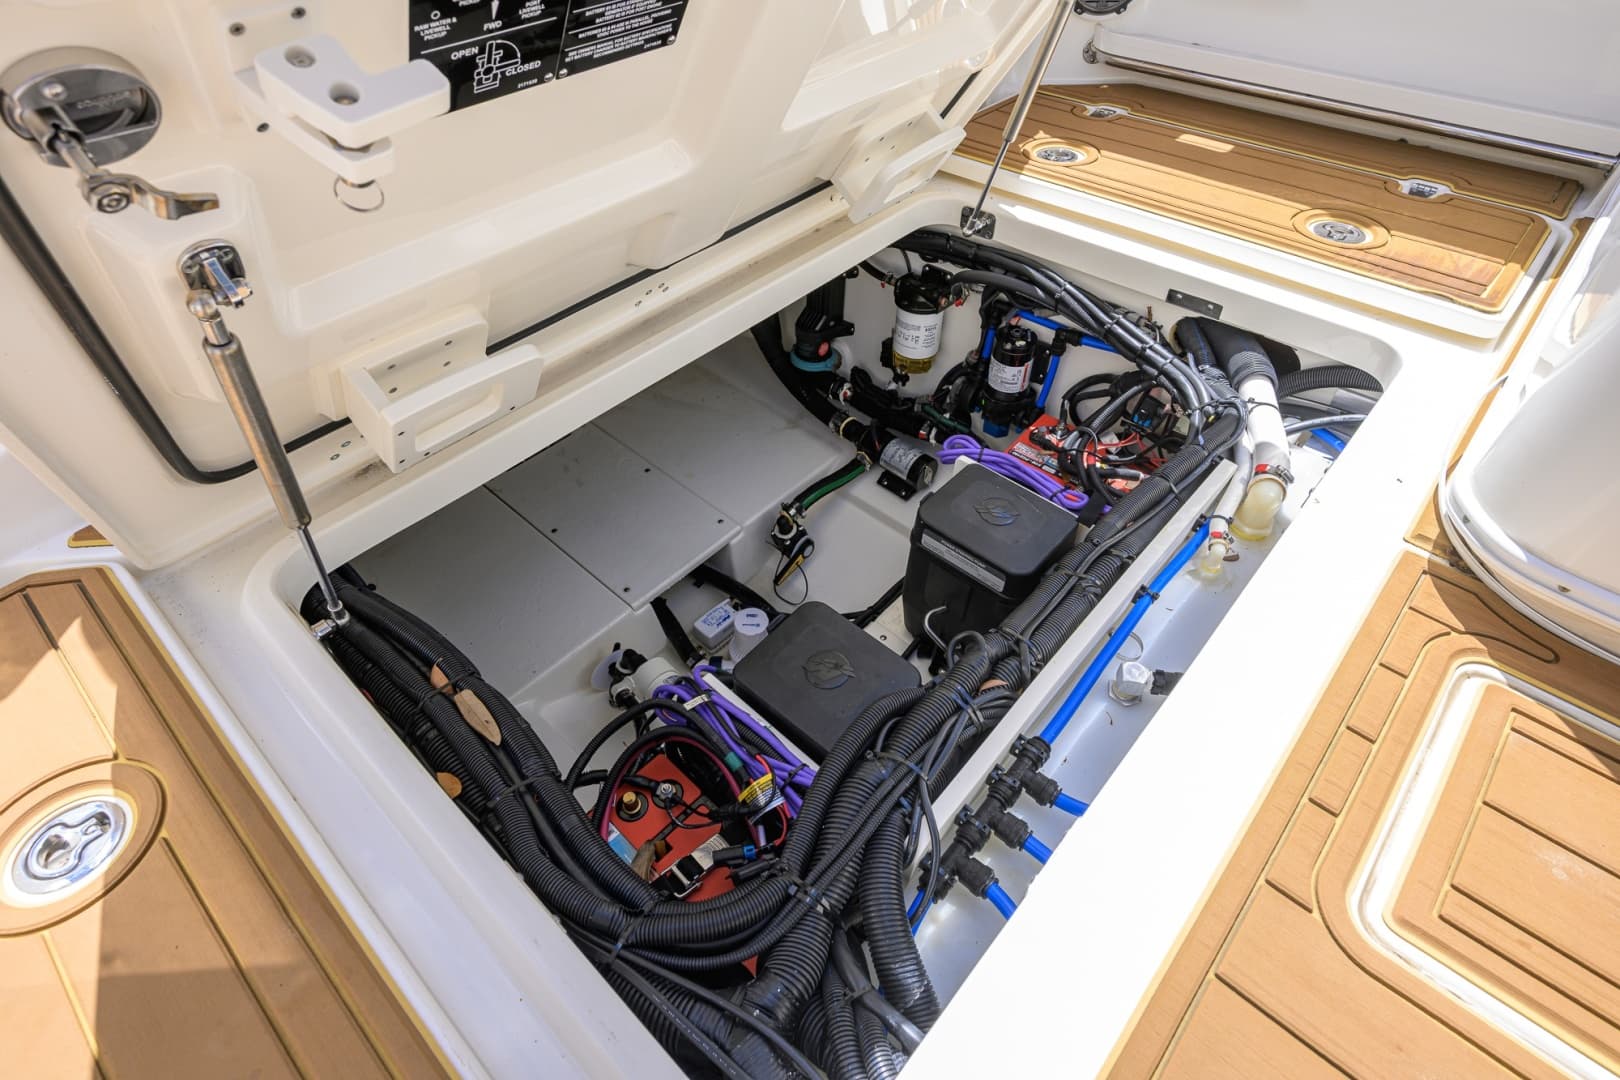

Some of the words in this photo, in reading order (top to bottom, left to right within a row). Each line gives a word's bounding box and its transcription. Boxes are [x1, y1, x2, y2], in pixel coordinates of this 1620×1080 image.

[519, 3, 545, 15] LIVEWELL
[521, 9, 542, 19] PICKUP
[414, 23, 429, 32] RAW
[430, 18, 452, 28] WATER
[420, 25, 451, 36] LIVEWELL
[483, 20, 502, 31] FWD
[424, 31, 447, 41] PICKUP
[451, 46, 479, 60] OPEN
[505, 60, 542, 77] CLOSED
